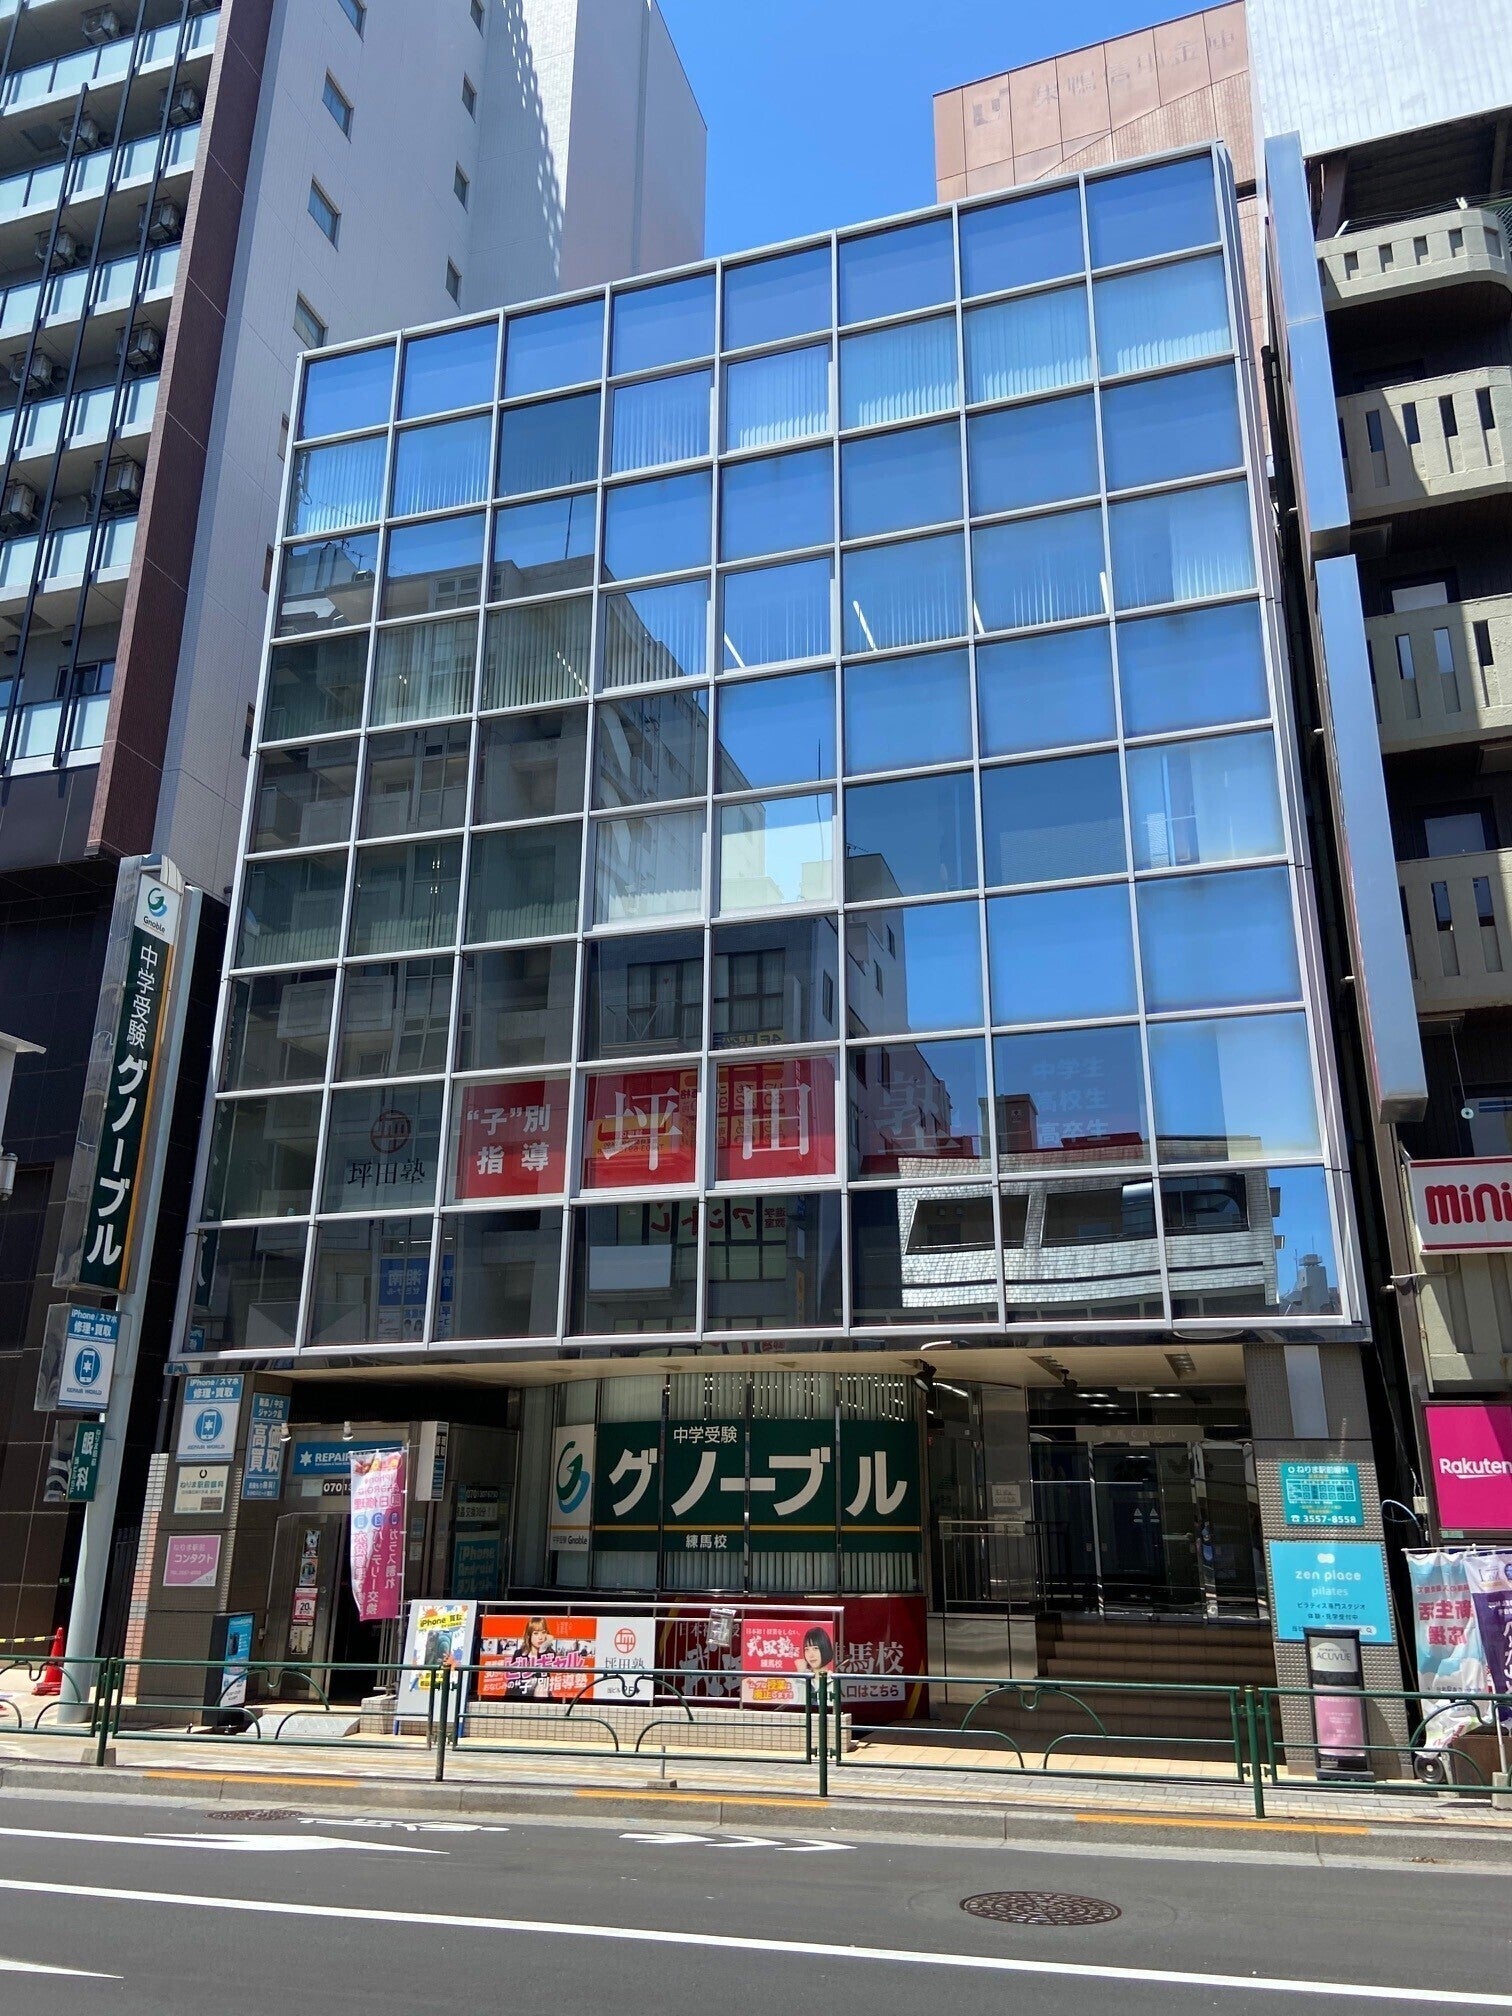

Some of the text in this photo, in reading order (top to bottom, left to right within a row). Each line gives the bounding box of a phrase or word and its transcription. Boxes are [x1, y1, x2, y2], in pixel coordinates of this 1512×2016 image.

[143, 914, 166, 934] Gnoble
[125, 944, 159, 1050] 中学受験
[1032, 1056, 1107, 1081] 中学生
[1034, 1087, 1109, 1113] 高校生
[86, 1054, 149, 1267] グノーブル
[476, 1143, 549, 1175] 指導
[347, 1159, 426, 1188] 坪田塾
[71, 1308, 96, 1320] iPhone
[100, 1313, 118, 1324] スマホ
[189, 1379, 215, 1387] iPhone
[220, 1377, 239, 1385] スマホ
[252, 1422, 281, 1449] 高価
[672, 1425, 739, 1445] 中学受験
[249, 1447, 280, 1473] 買取
[1438, 1457, 1512, 1475] Rakuten
[323, 1482, 343, 1493] 070
[608, 1446, 909, 1518] グノーブル
[1302, 1514, 1357, 1524] 3557-8558
[567, 1535, 588, 1546] Gnoble
[685, 1533, 728, 1550] 練馬校
[173, 1553, 214, 1564] コンタクト
[1294, 1569, 1362, 1582] zen place
[1311, 1586, 1350, 1597] pilates
[420, 1617, 448, 1628] iPhone
[1316, 1652, 1352, 1662] ACUVUE
